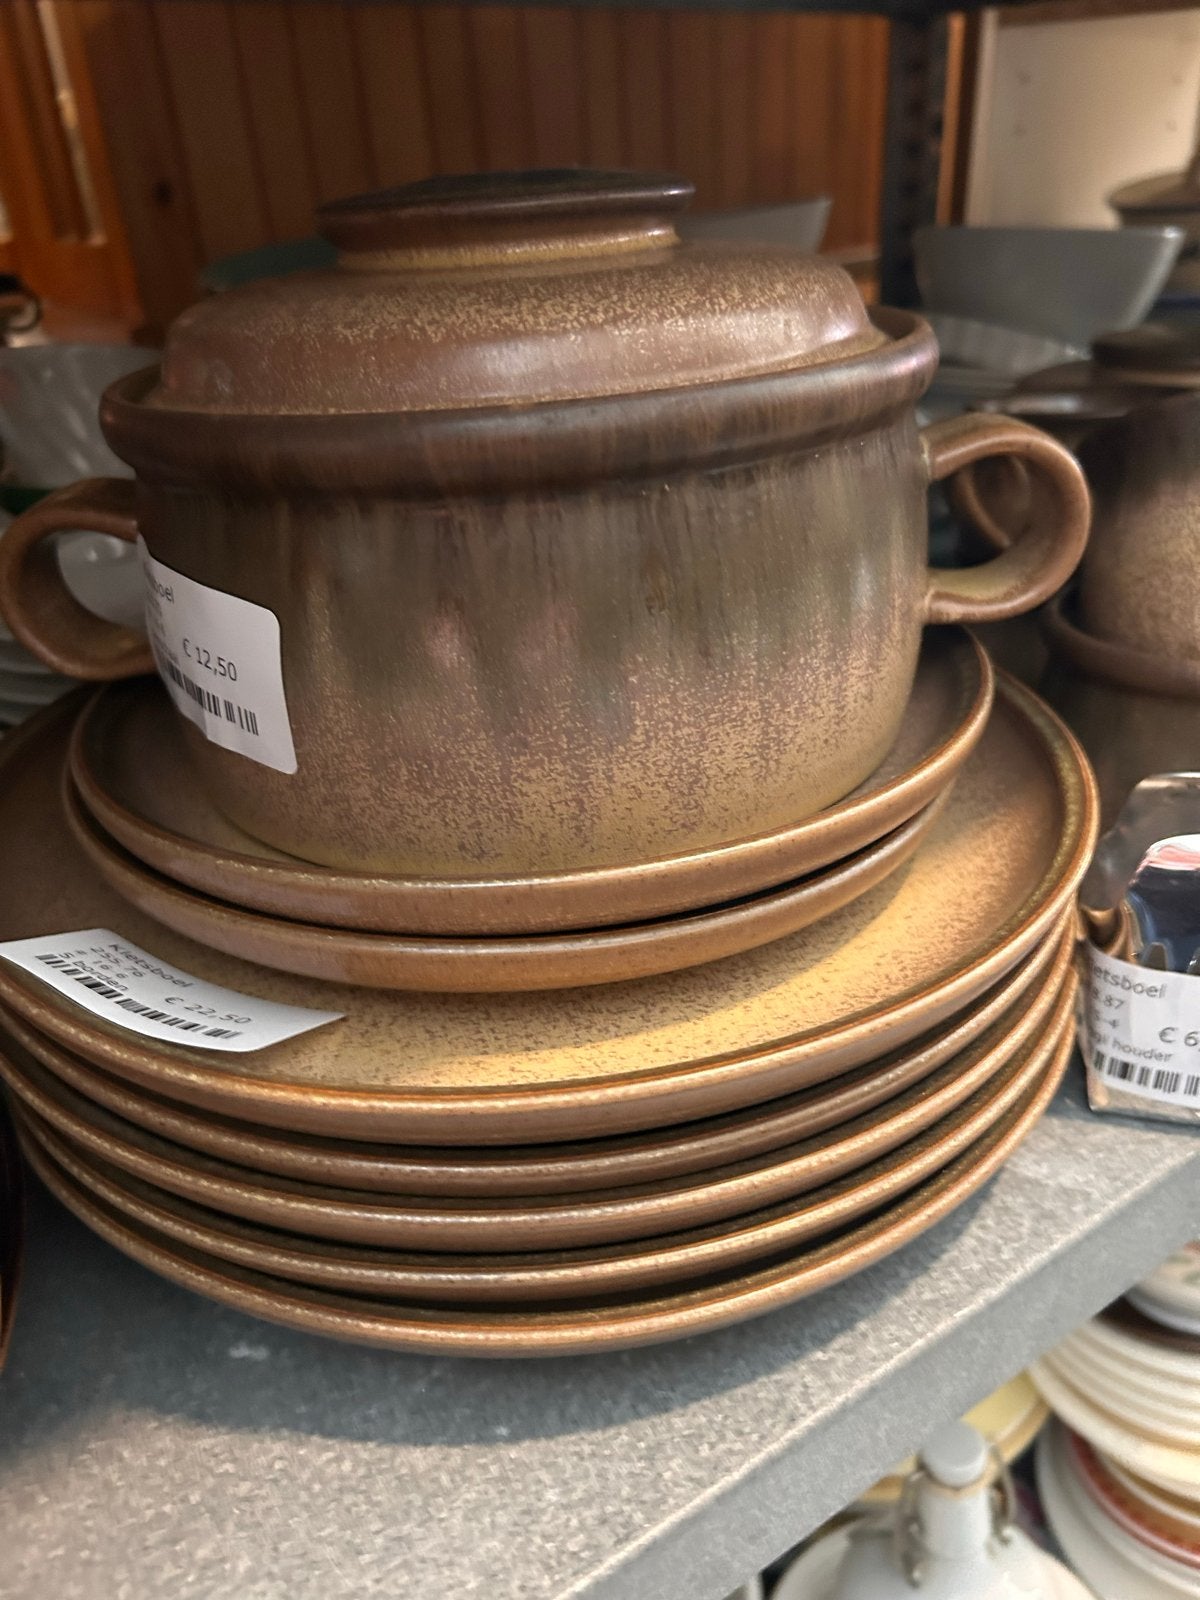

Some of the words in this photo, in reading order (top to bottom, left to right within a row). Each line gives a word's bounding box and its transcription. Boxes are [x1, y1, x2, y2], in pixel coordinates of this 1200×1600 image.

[183, 638, 192, 658] €
[195, 646, 238, 682] 12,50
[59, 951, 75, 960] 5
[72, 960, 129, 992] borden
[108, 943, 193, 988] Kletsboel
[1094, 966, 1167, 999] etsboel
[164, 996, 183, 1005] €
[183, 1003, 252, 1026] 22,50
[1111, 1038, 1173, 1062] houder
[1158, 1026, 1178, 1044] €
